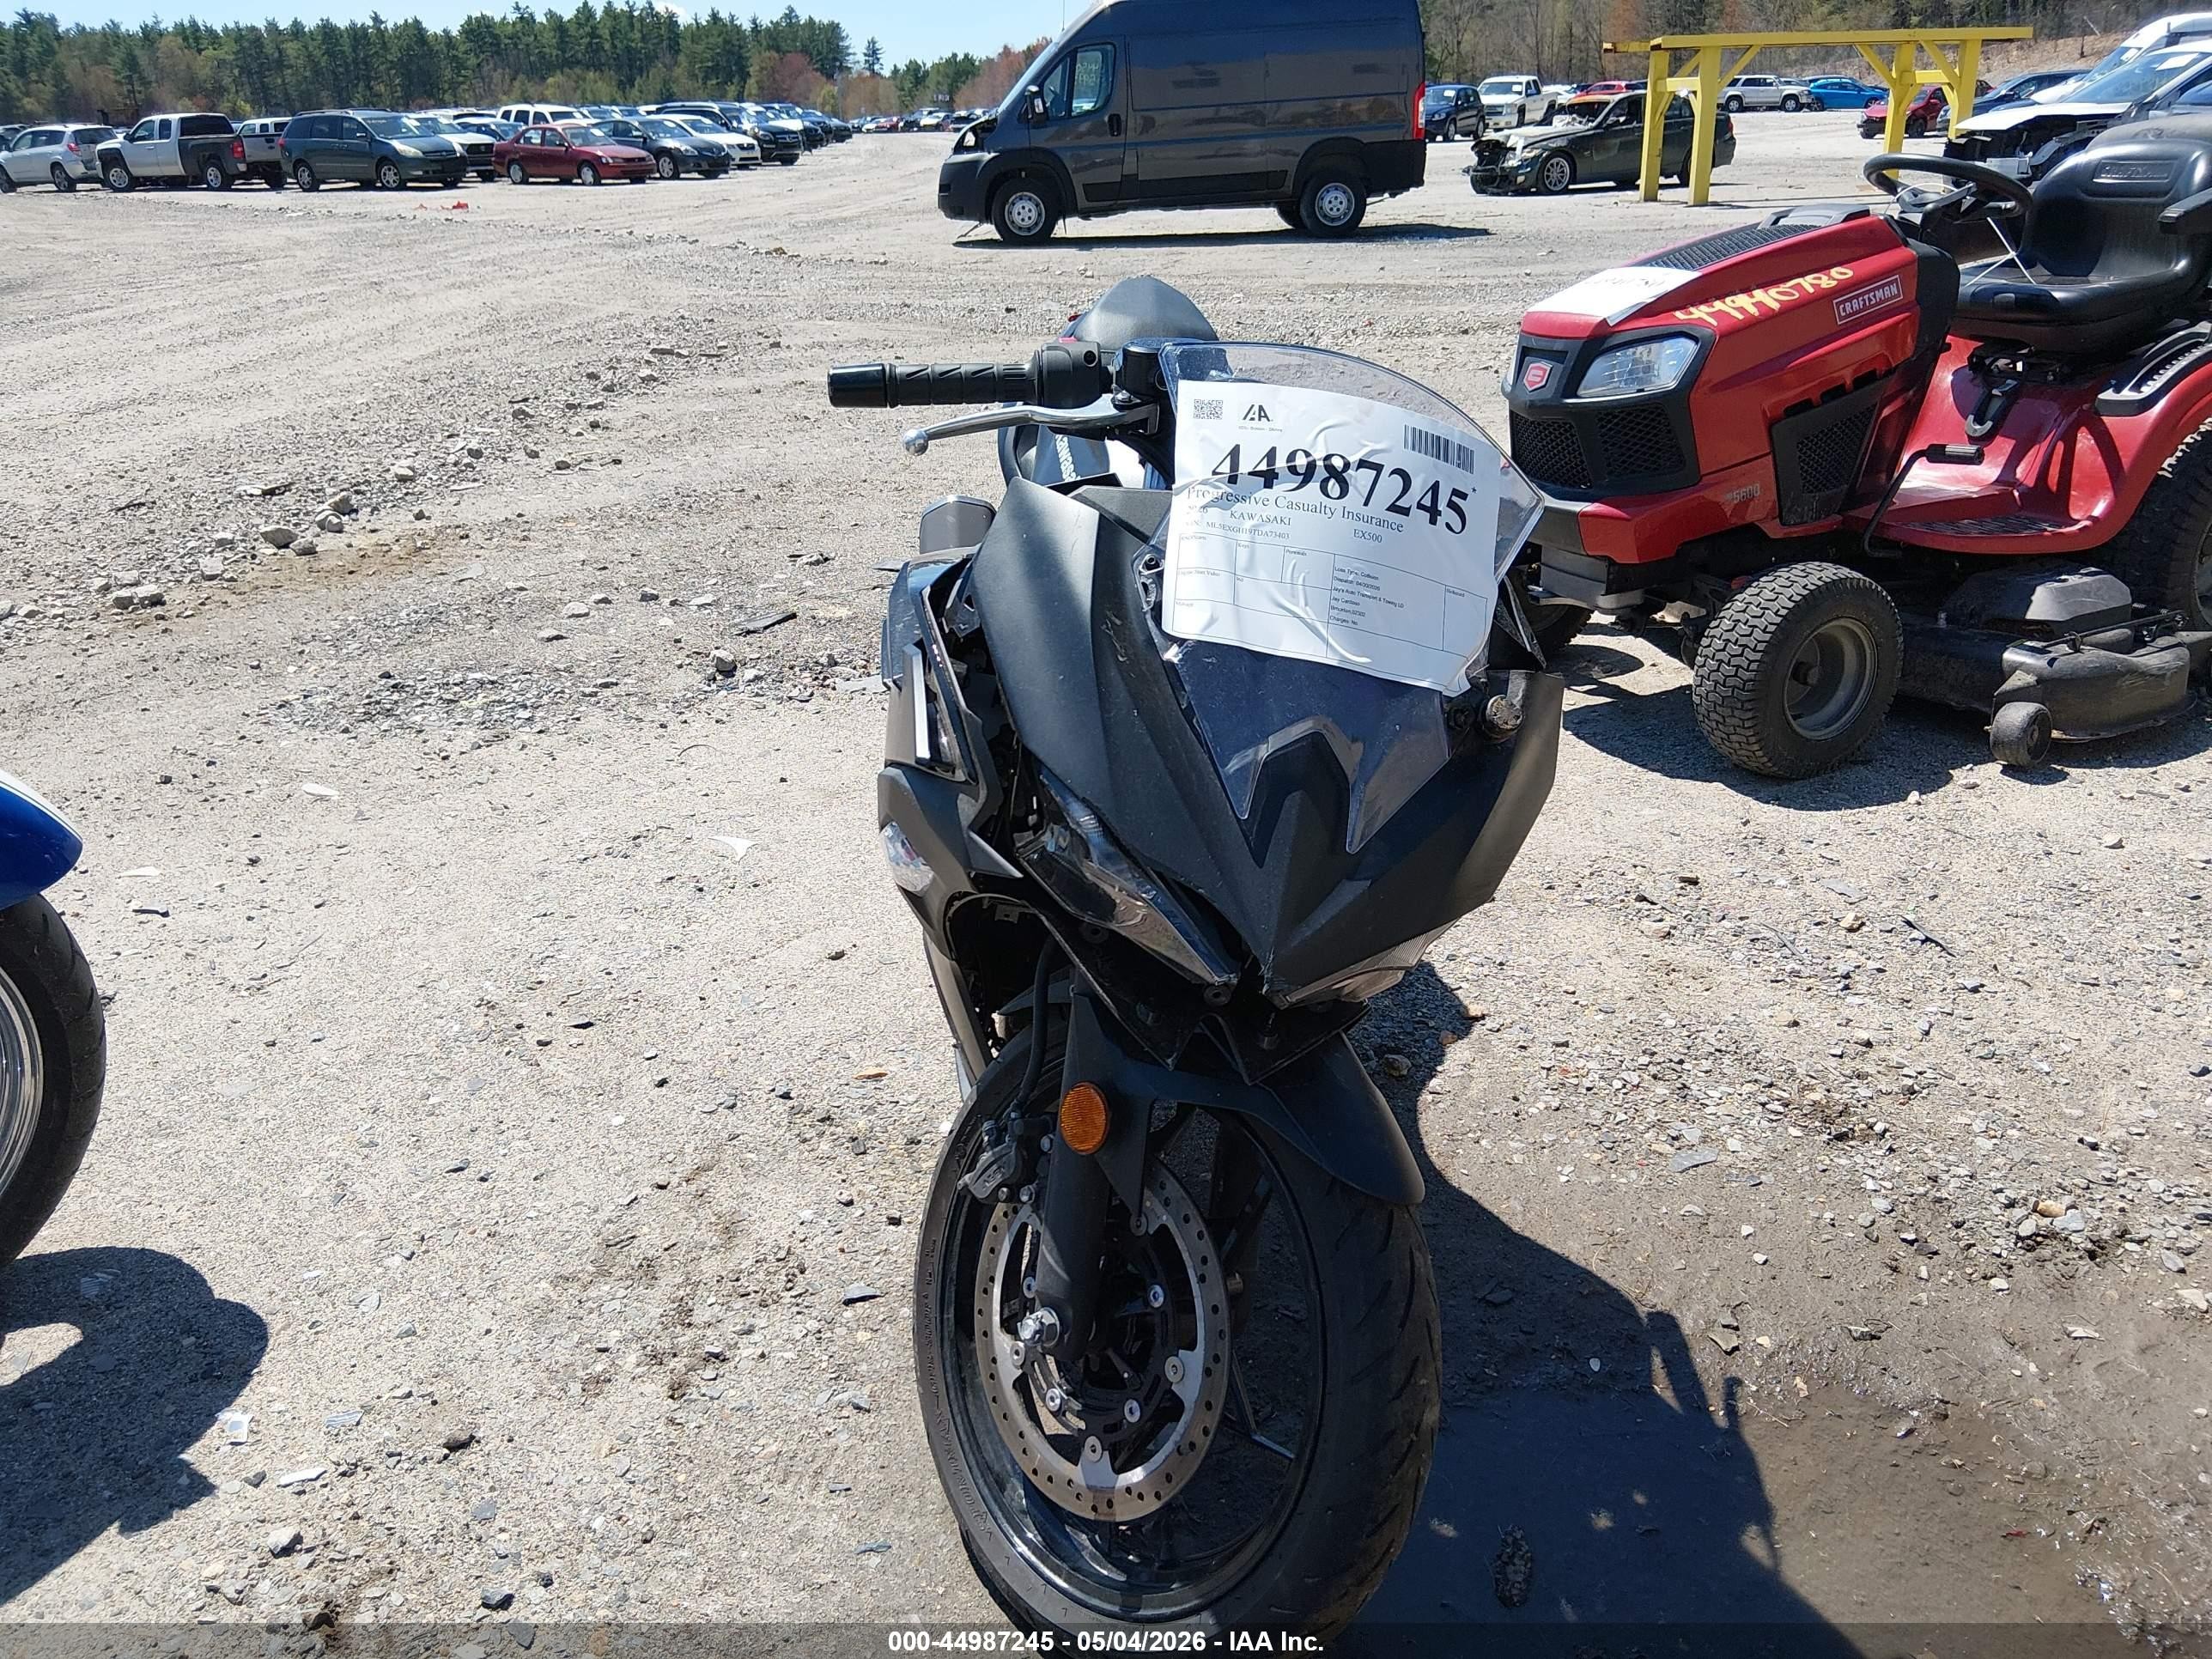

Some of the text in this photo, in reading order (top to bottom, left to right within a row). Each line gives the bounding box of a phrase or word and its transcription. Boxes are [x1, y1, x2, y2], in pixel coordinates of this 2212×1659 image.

[1838, 282, 1899, 317] CRAFTSMAN
[1229, 510, 1291, 526] KAWASAKI
[1274, 495, 1337, 520] Casualty
[1341, 506, 1404, 532] Insurance
[1353, 528, 1382, 544] EX500
